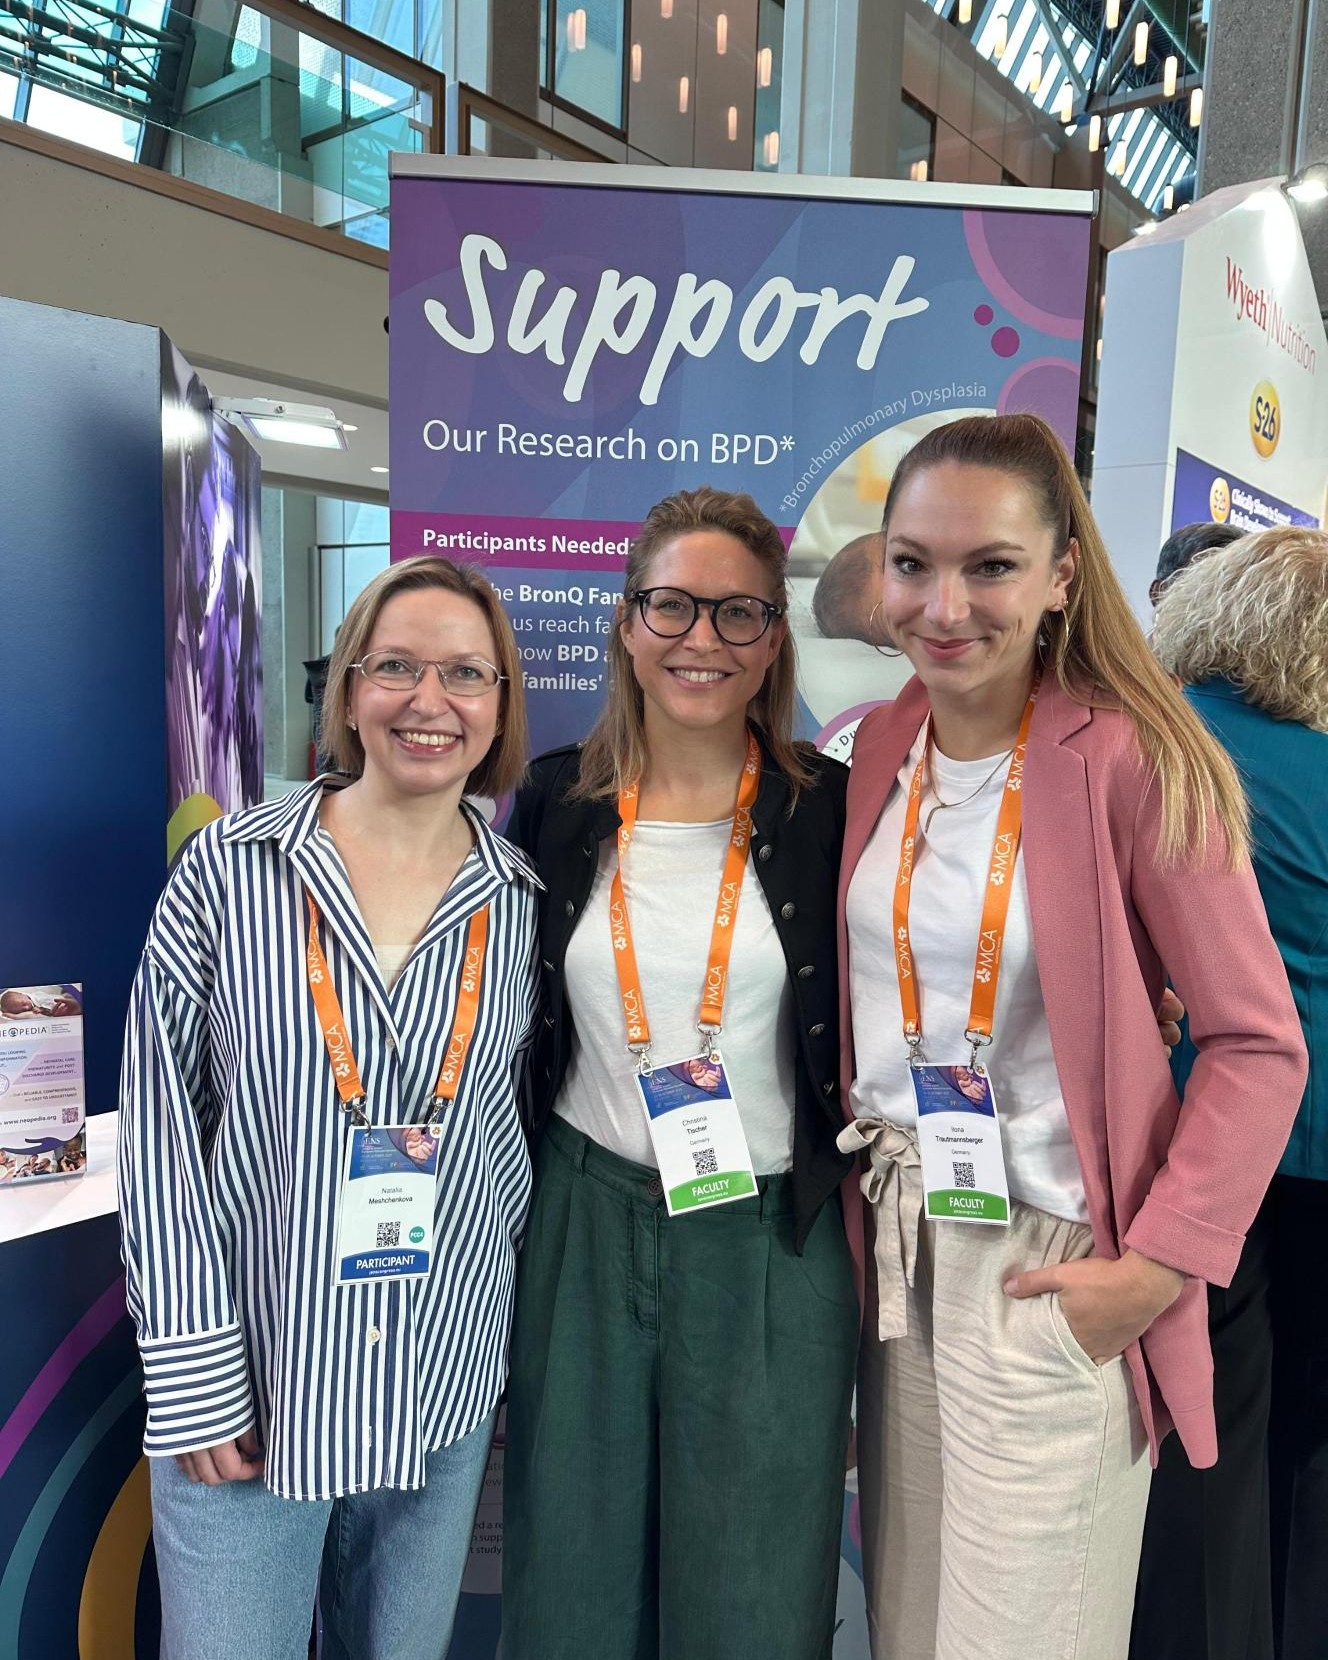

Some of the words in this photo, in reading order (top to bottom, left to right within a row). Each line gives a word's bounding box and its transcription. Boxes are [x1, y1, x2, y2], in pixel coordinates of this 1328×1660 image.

[424, 233, 929, 405] Support
[1226, 256, 1267, 332] Wyeth
[1271, 300, 1316, 375] Nutrition
[911, 382, 987, 406] Dysplasia
[423, 419, 488, 453] Our
[498, 423, 646, 460] Research
[657, 438, 699, 462] on
[423, 529, 546, 554] Participants
[519, 584, 583, 606] BronQ
[513, 618, 533, 631] us
[539, 616, 590, 633] reach
[595, 616, 611, 633] fa
[557, 644, 599, 662] BPD
[522, 672, 602, 691] families'
[900, 851, 912, 886] MCA
[992, 832, 1013, 870] MCA
[720, 882, 737, 914] MCA
[611, 900, 625, 935] MCA
[466, 947, 480, 980] MCA
[899, 942, 911, 979] MCA
[978, 929, 998, 968] MCA
[707, 966, 722, 1002] MCA
[623, 988, 641, 1024] MCA
[325, 1024, 348, 1062] MCA
[448, 1033, 466, 1069] MCA
[692, 1179, 729, 1197] FACULTY
[949, 1197, 985, 1209] FACULTY
[356, 1254, 416, 1270] PARTICIPANT
